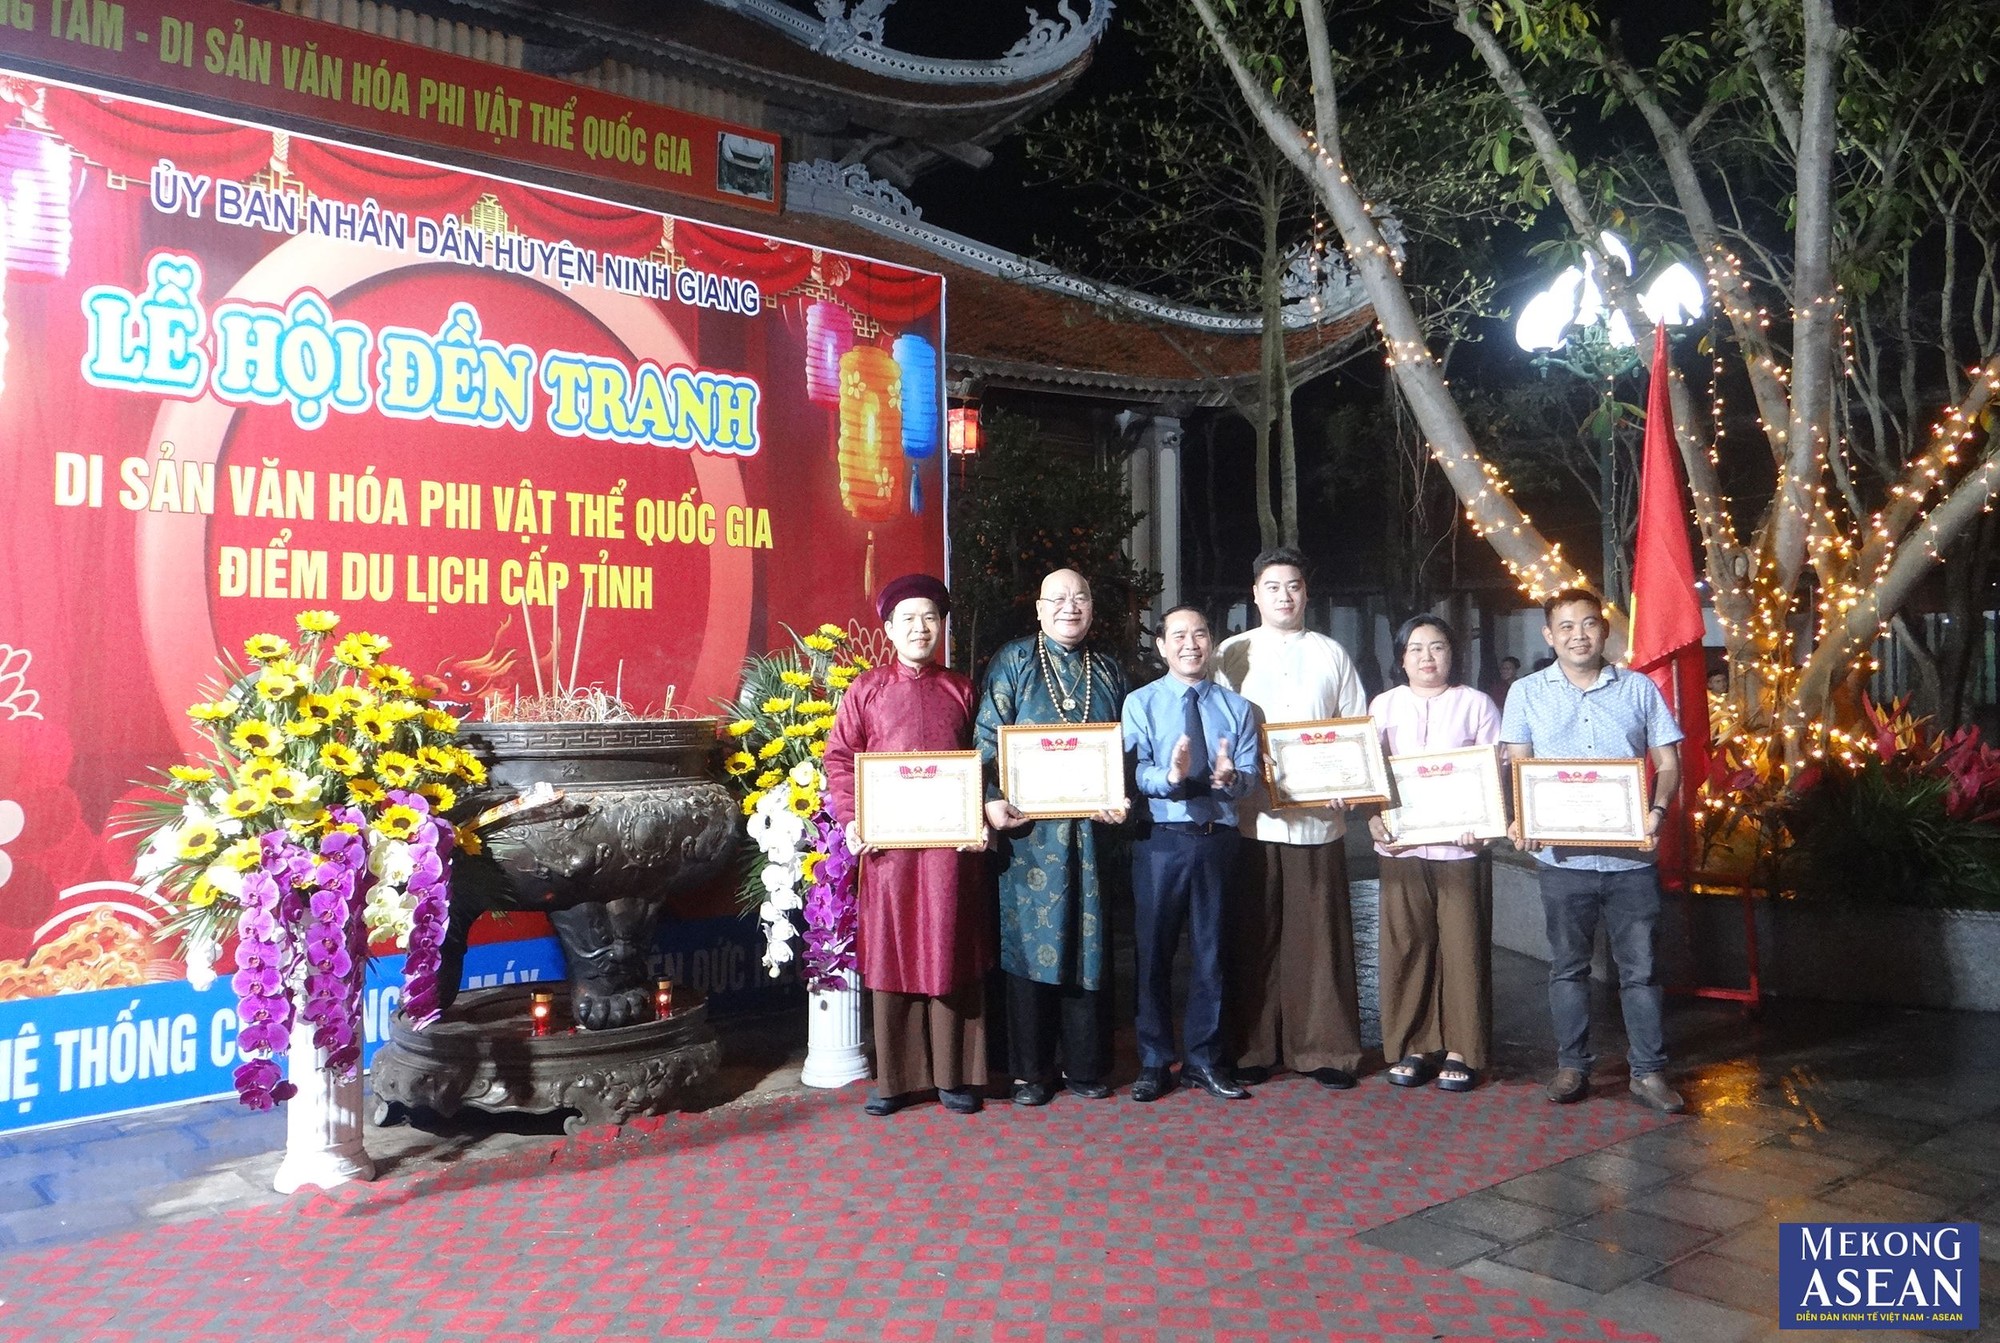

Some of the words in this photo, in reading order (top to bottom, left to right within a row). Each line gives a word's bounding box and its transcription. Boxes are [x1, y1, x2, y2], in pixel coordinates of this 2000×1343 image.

[160, 16, 194, 68] DI
[204, 18, 272, 86] SẢN
[282, 41, 343, 101] VĂN
[352, 59, 410, 116] HÓA
[419, 77, 466, 128] PHI
[474, 86, 522, 145] VẬT
[530, 95, 575, 151] THỂ
[582, 111, 648, 167] QUỐC
[654, 132, 693, 177] GIA
[154, 162, 207, 214] ỦY
[219, 183, 295, 231] BAN
[309, 201, 405, 250] NHÂN
[417, 218, 483, 263] DÂN
[495, 235, 595, 287] HUYỆN
[605, 256, 669, 297] NINH
[677, 272, 759, 312] GIANG
[86, 256, 204, 391] LỄ
[216, 296, 369, 424] HỘI
[380, 306, 533, 427] ĐỀN
[544, 353, 758, 452] TRANH
[54, 451, 104, 508] DI
[118, 441, 216, 515] SẢN
[228, 456, 316, 521] VĂN
[328, 466, 409, 526] HÓA
[420, 479, 482, 531] PHI
[492, 478, 557, 544] VẬT
[565, 478, 626, 540] THỂ
[635, 486, 717, 547] QUỐC
[725, 504, 774, 550] GIA
[218, 528, 329, 601] ĐIỂM
[342, 551, 395, 603] DU
[406, 555, 489, 615] LỊCH
[500, 545, 570, 607] CẤP
[579, 549, 653, 610] TỈNH
[53, 999, 198, 1093] THỐNG
